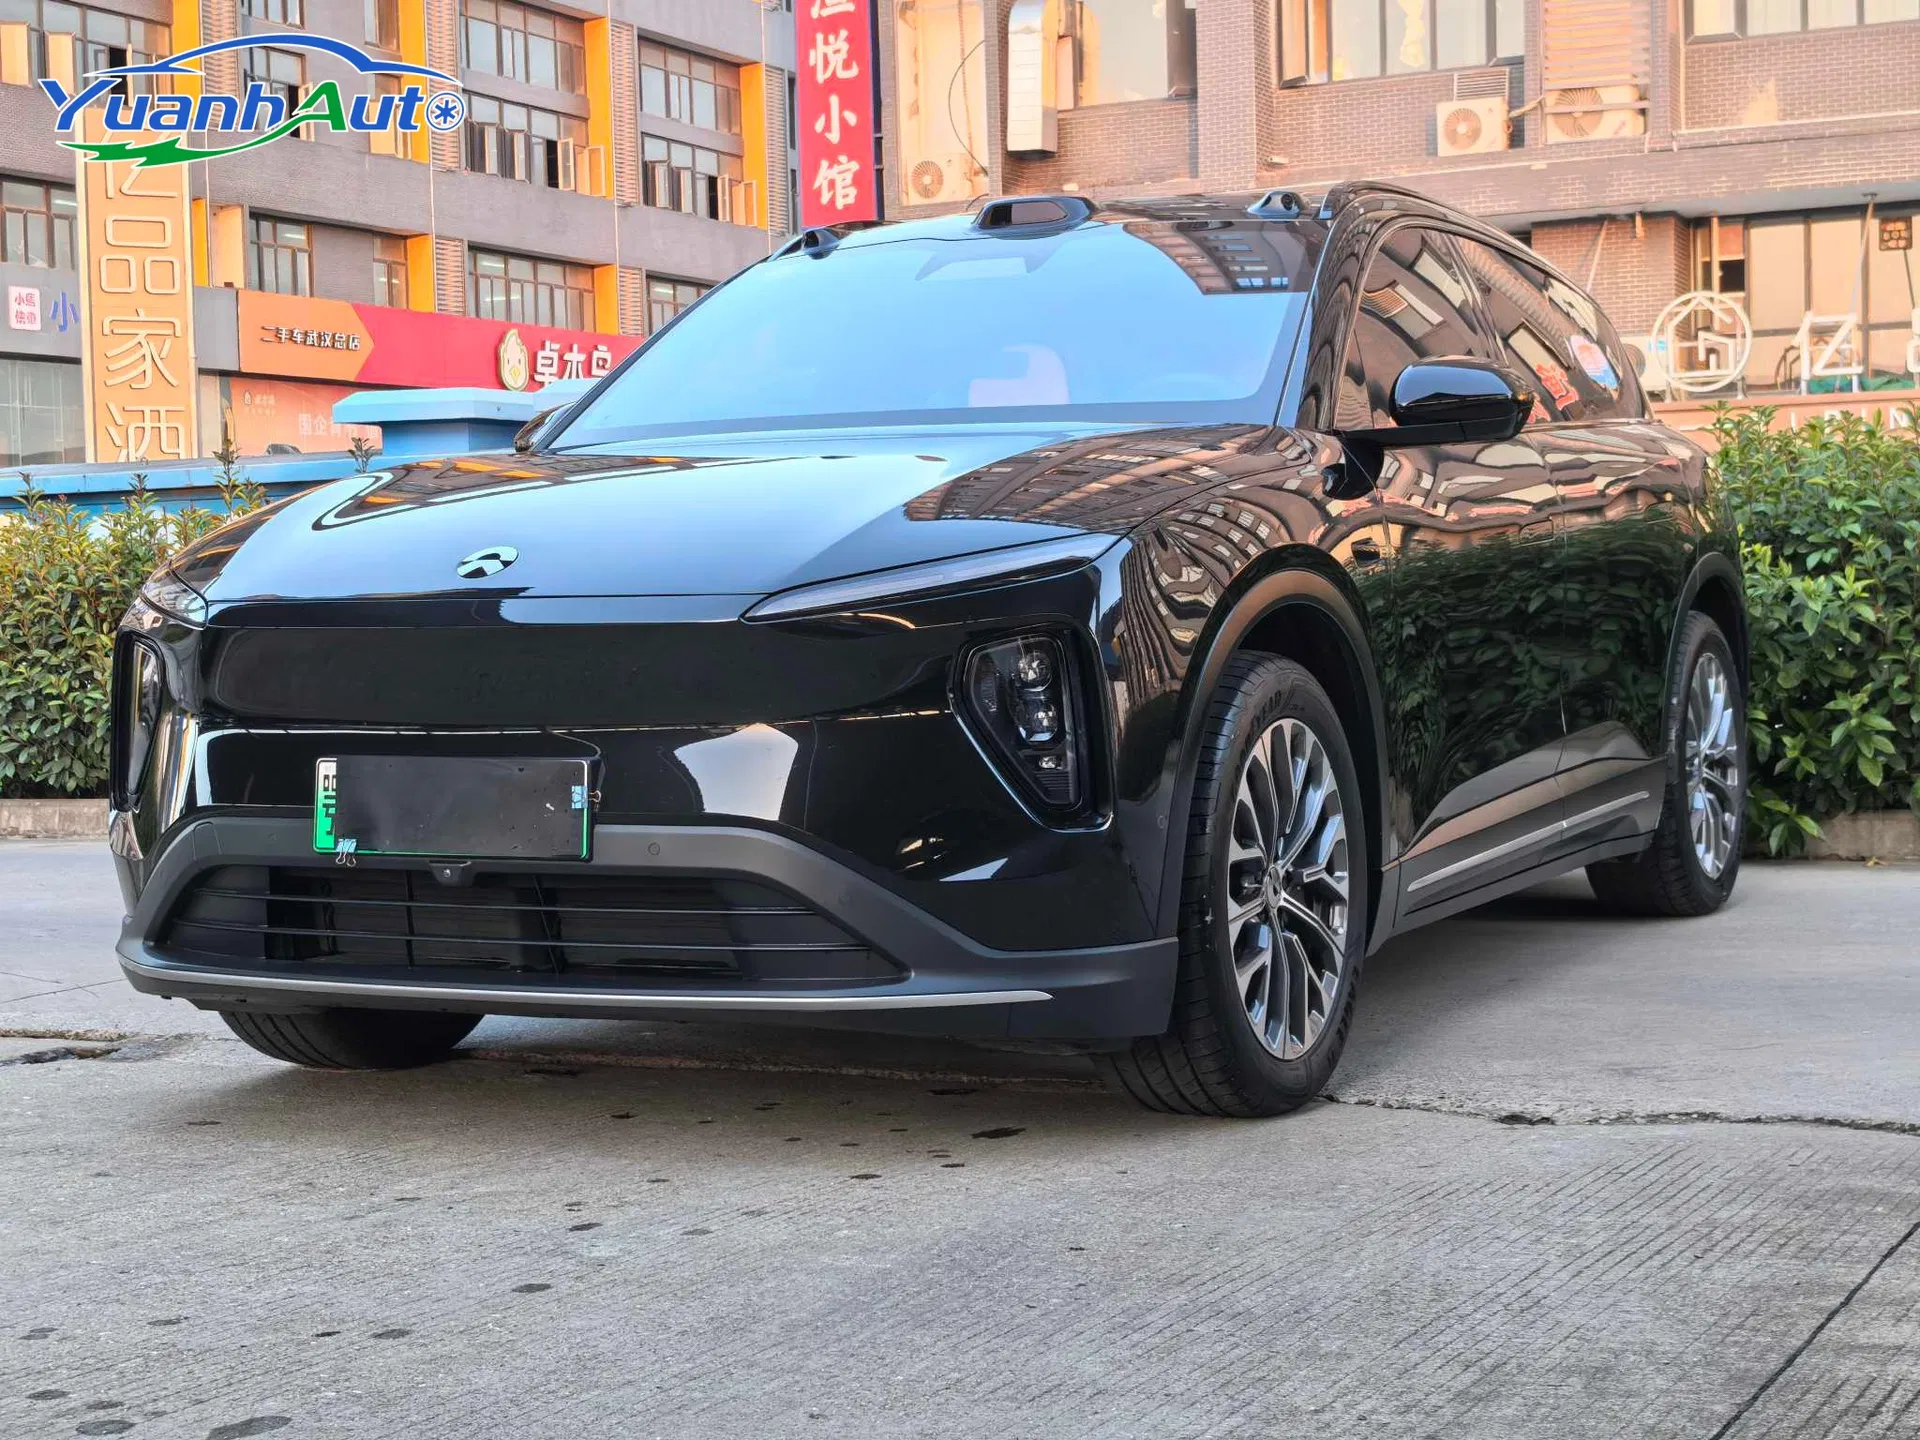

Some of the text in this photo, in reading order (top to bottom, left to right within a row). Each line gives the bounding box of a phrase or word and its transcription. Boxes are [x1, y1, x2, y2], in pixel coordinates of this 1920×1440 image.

[261, 326, 360, 351] 二手车武汉总店
